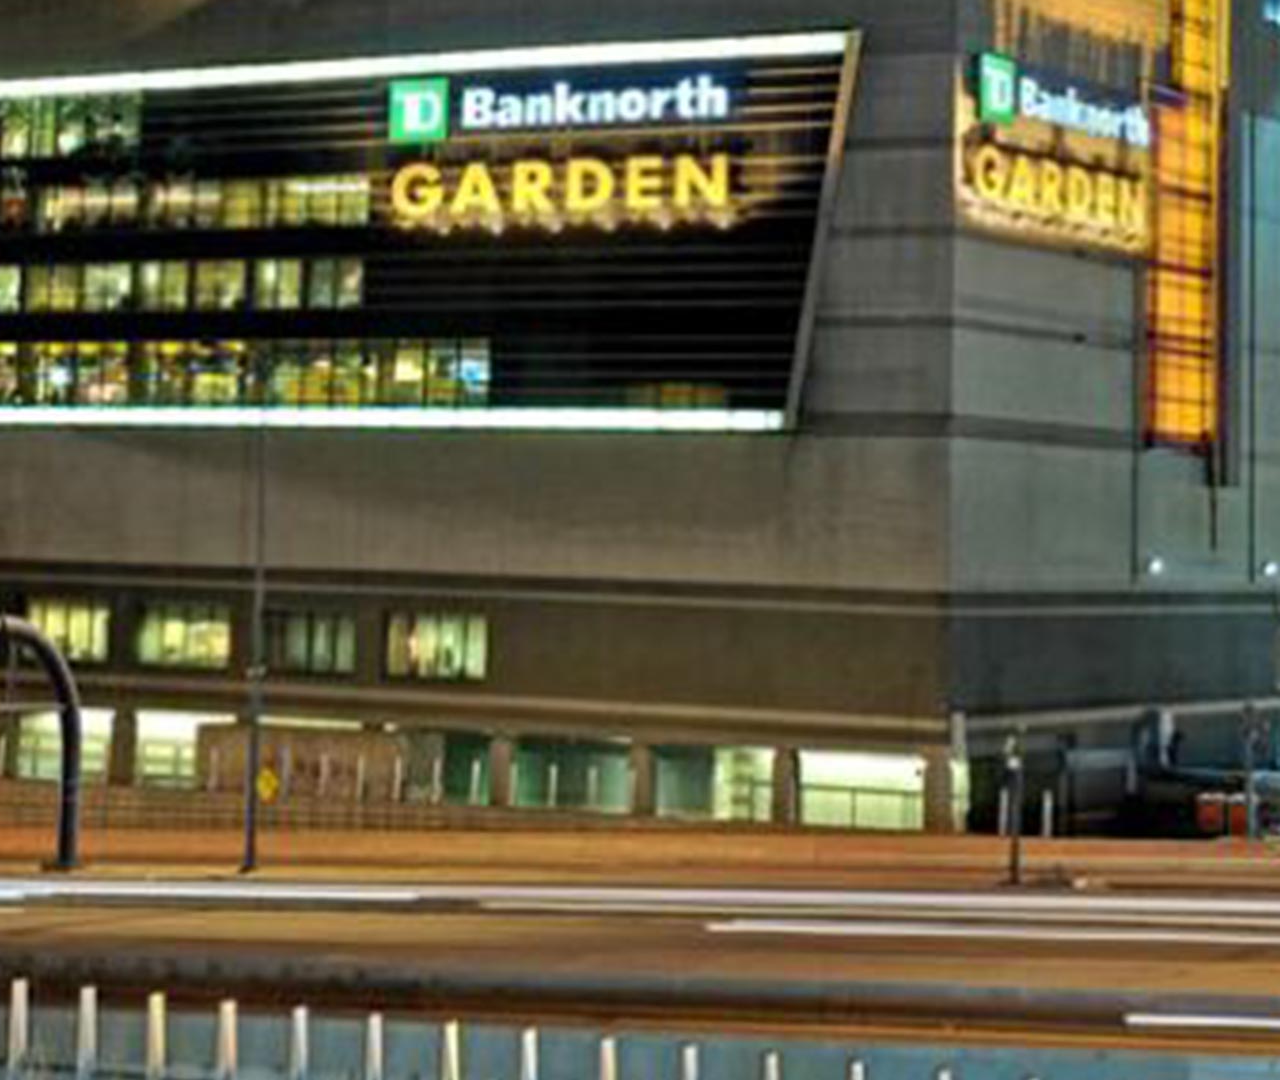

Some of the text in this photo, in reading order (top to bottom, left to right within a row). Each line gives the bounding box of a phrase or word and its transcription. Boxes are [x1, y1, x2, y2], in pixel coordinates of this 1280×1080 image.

[395, 74, 730, 134] TD Banknorth
[1021, 76, 1150, 146] Banknorth
[391, 153, 729, 217] GARDEN
[975, 146, 1149, 230] GARDEN
